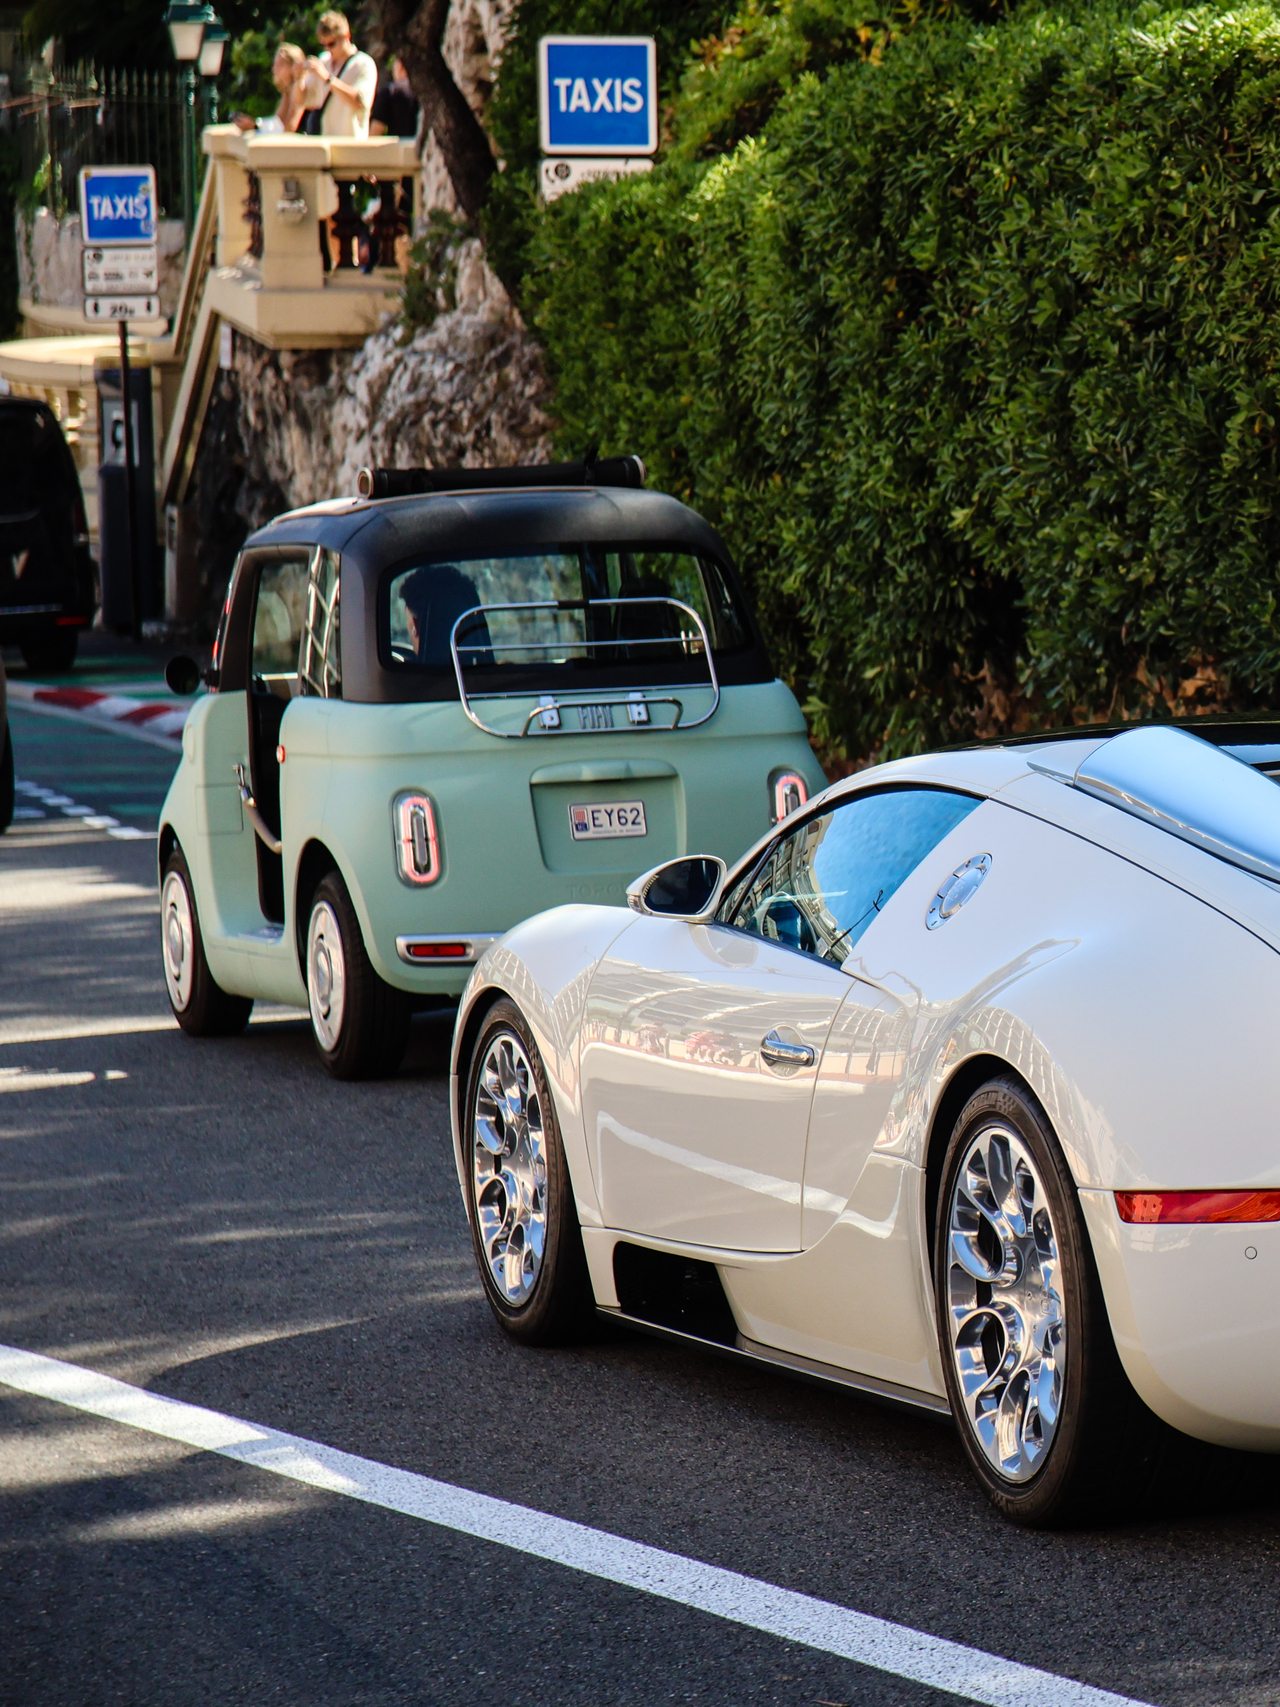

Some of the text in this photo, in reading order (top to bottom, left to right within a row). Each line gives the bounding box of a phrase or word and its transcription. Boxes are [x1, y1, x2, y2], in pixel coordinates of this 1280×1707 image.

[553, 77, 644, 113] TAXIS
[89, 193, 148, 220] TAXIS
[590, 807, 642, 828] EY62
